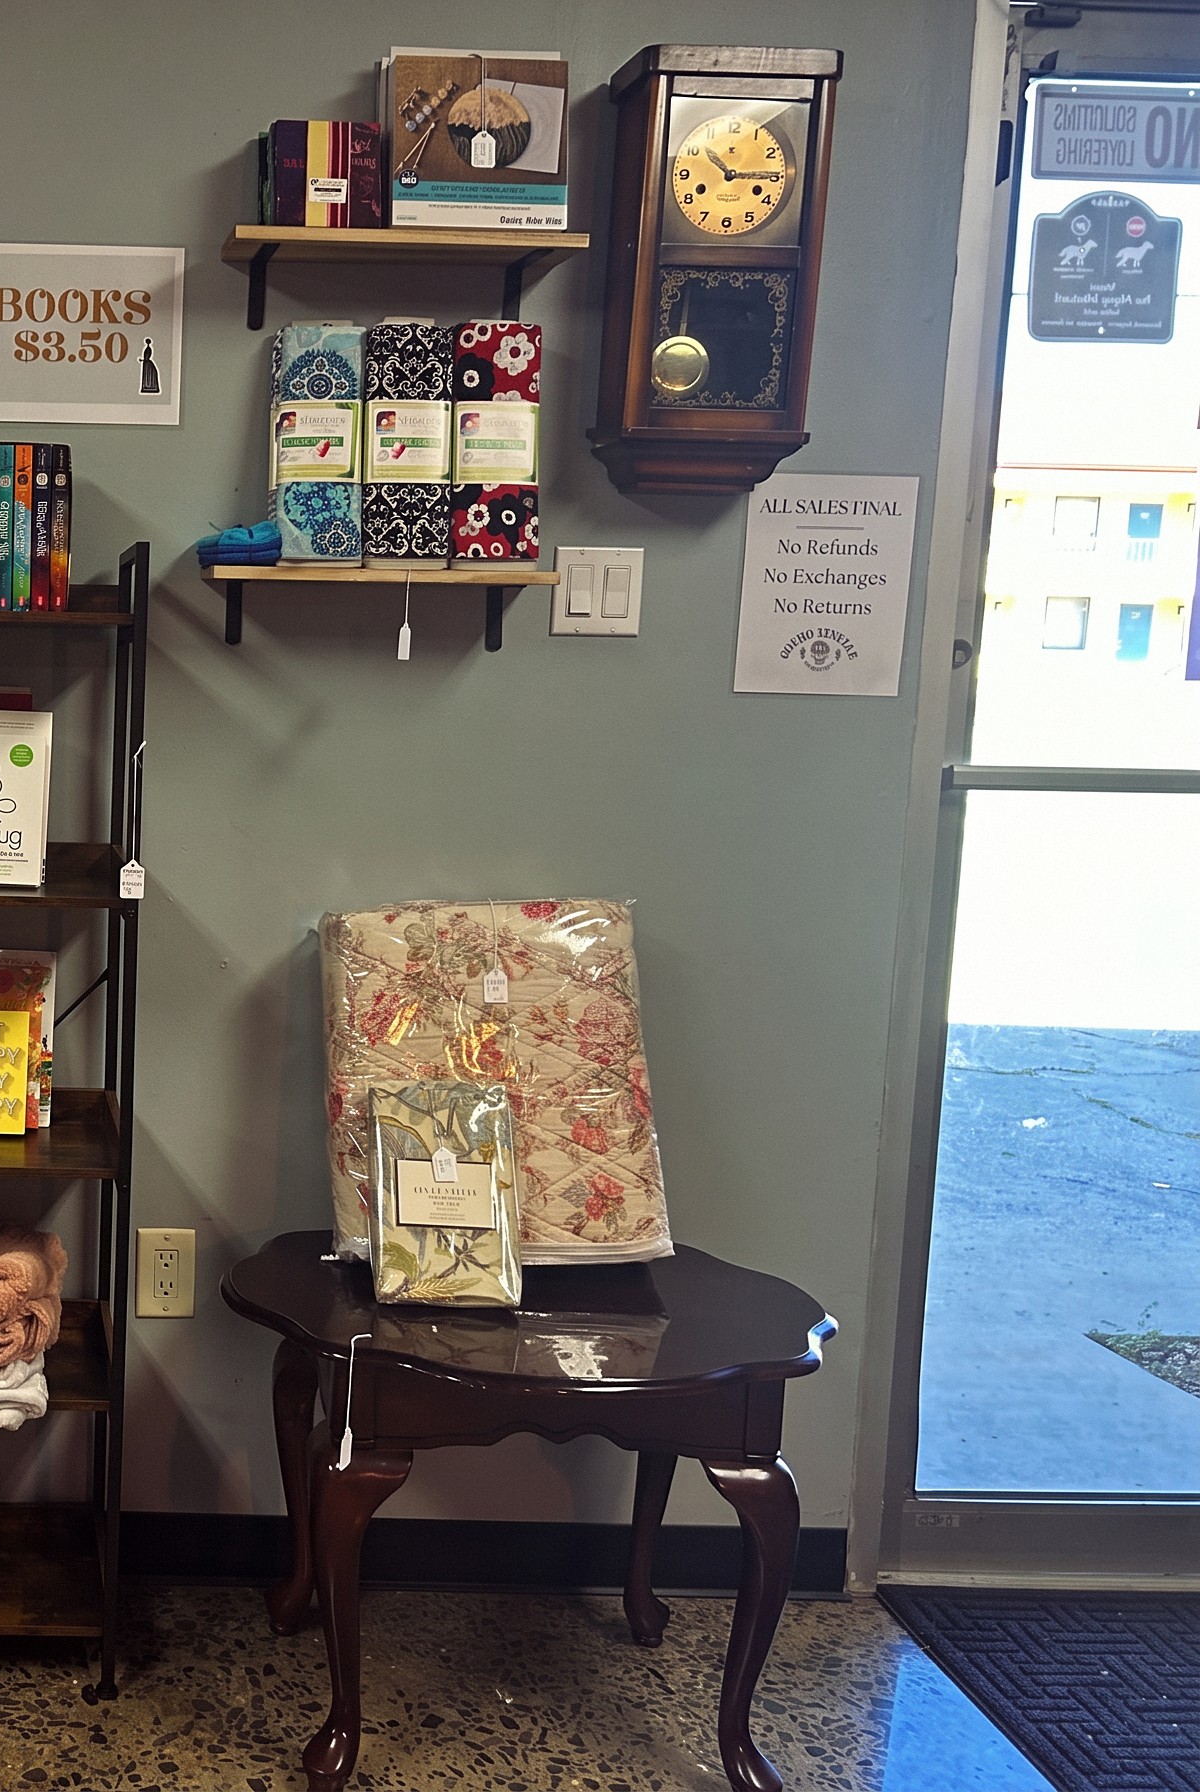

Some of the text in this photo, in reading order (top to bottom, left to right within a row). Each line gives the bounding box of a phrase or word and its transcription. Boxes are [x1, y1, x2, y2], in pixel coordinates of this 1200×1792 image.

[728, 121, 741, 134] 12
[687, 146, 699, 156] 10
[765, 147, 776, 159] 2
[679, 169, 690, 180] 9
[683, 193, 694, 204] 8
[761, 194, 772, 205] 4
[700, 211, 710, 222] 7
[721, 217, 732, 228] 6
[744, 211, 755, 223] 5
[14, 328, 129, 363] $3.50
[760, 498, 792, 514] ALL
[795, 499, 849, 515] SALES
[777, 538, 879, 556] No Refunds
[763, 568, 887, 590] No Exchanges
[774, 598, 872, 616] No Returns
